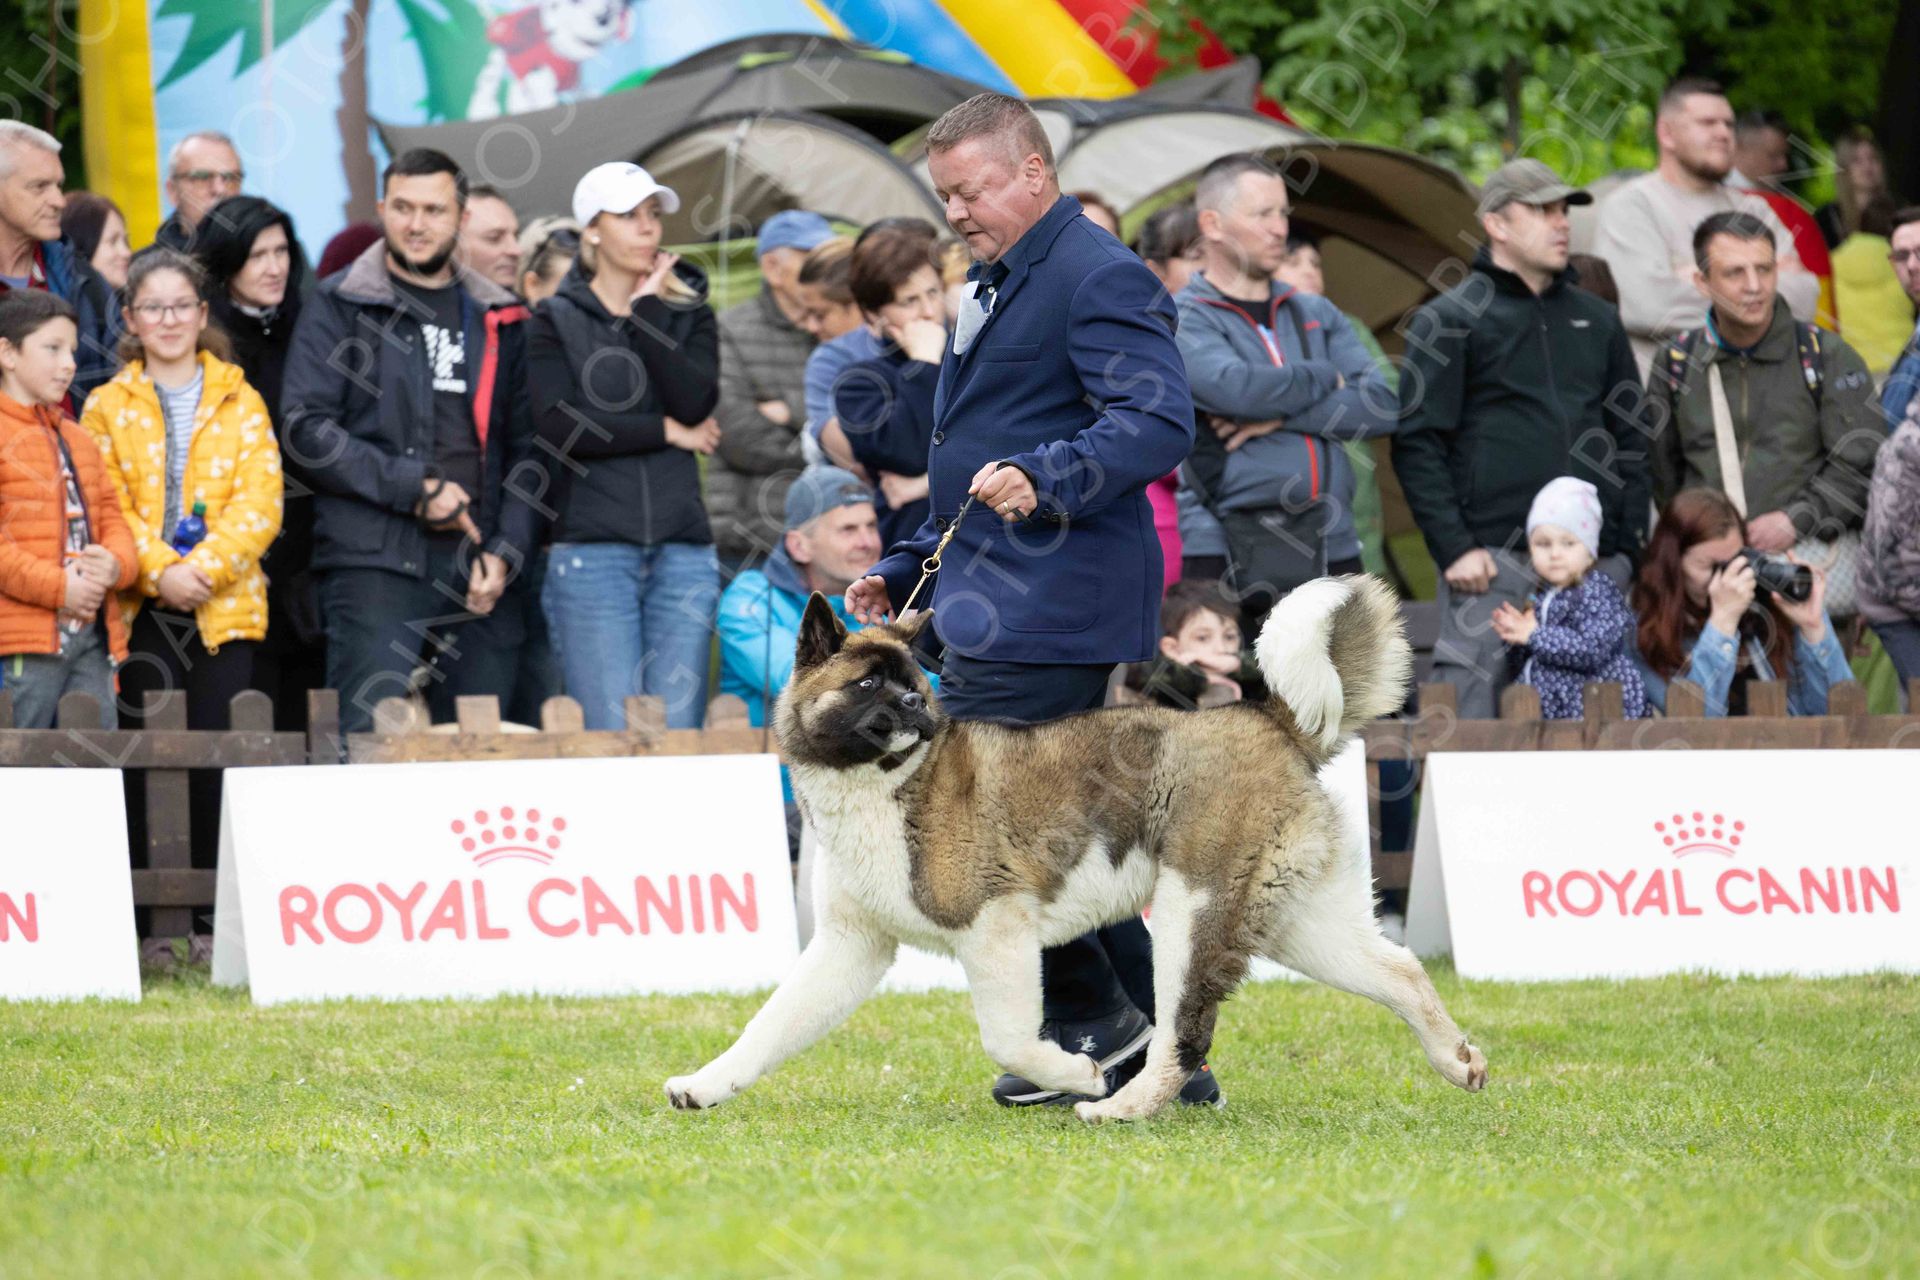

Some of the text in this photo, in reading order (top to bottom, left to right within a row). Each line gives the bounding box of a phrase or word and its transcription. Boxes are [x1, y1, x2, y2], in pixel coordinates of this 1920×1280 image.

[280, 873, 757, 945] ROYAL CANIN
[1522, 867, 1900, 918] ROYAL CANIN
